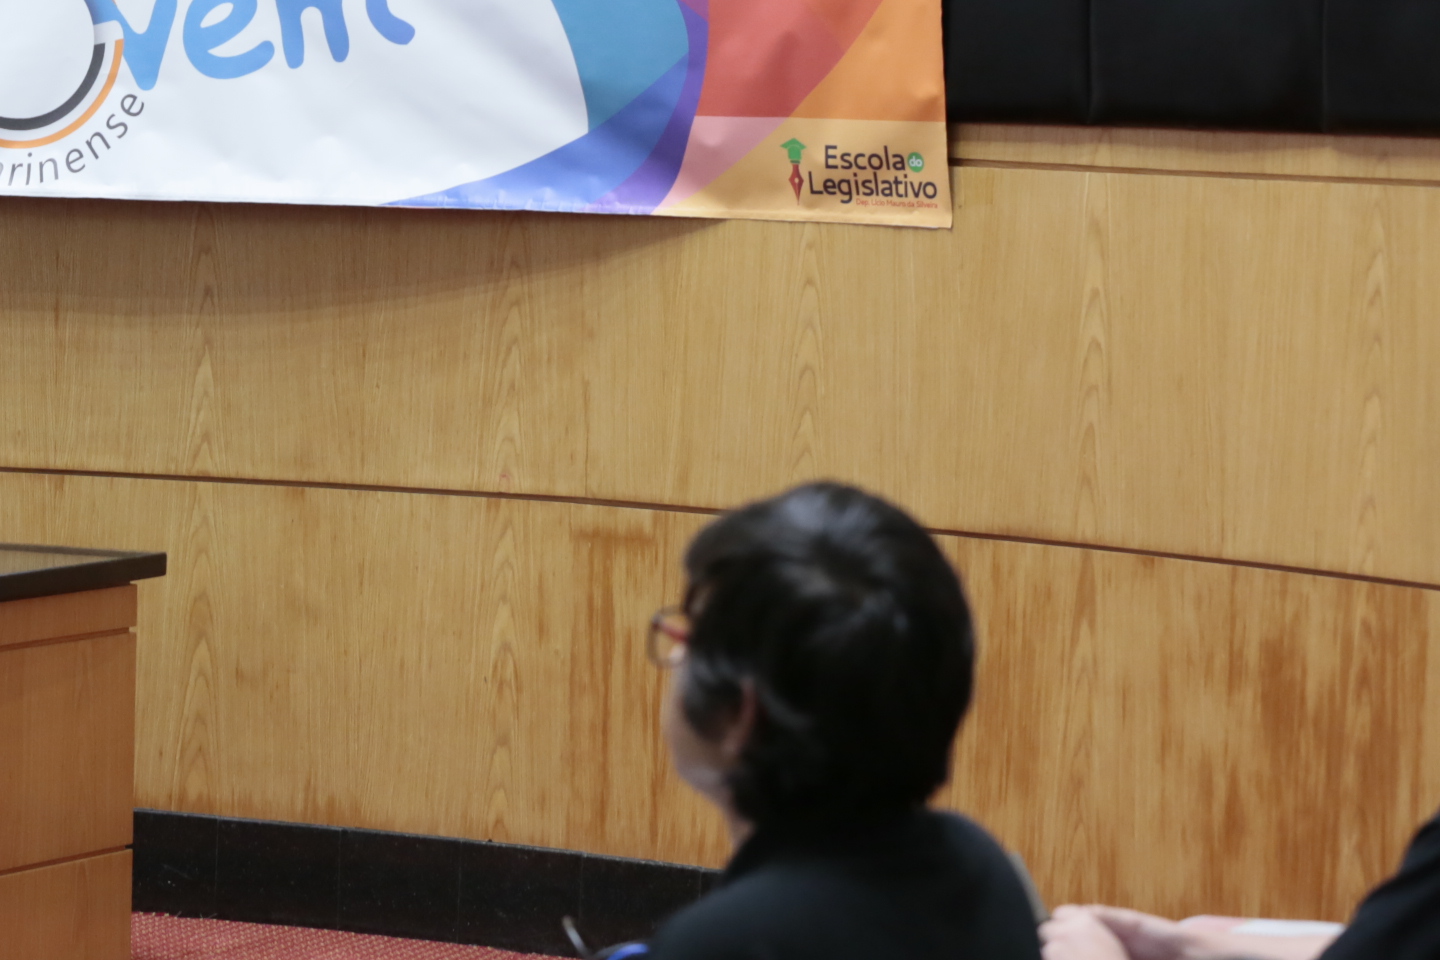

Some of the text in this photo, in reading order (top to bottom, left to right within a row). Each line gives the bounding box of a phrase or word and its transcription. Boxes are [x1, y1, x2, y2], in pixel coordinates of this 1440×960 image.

[824, 145, 923, 171] Escola do
[808, 170, 938, 204] Legislativo
